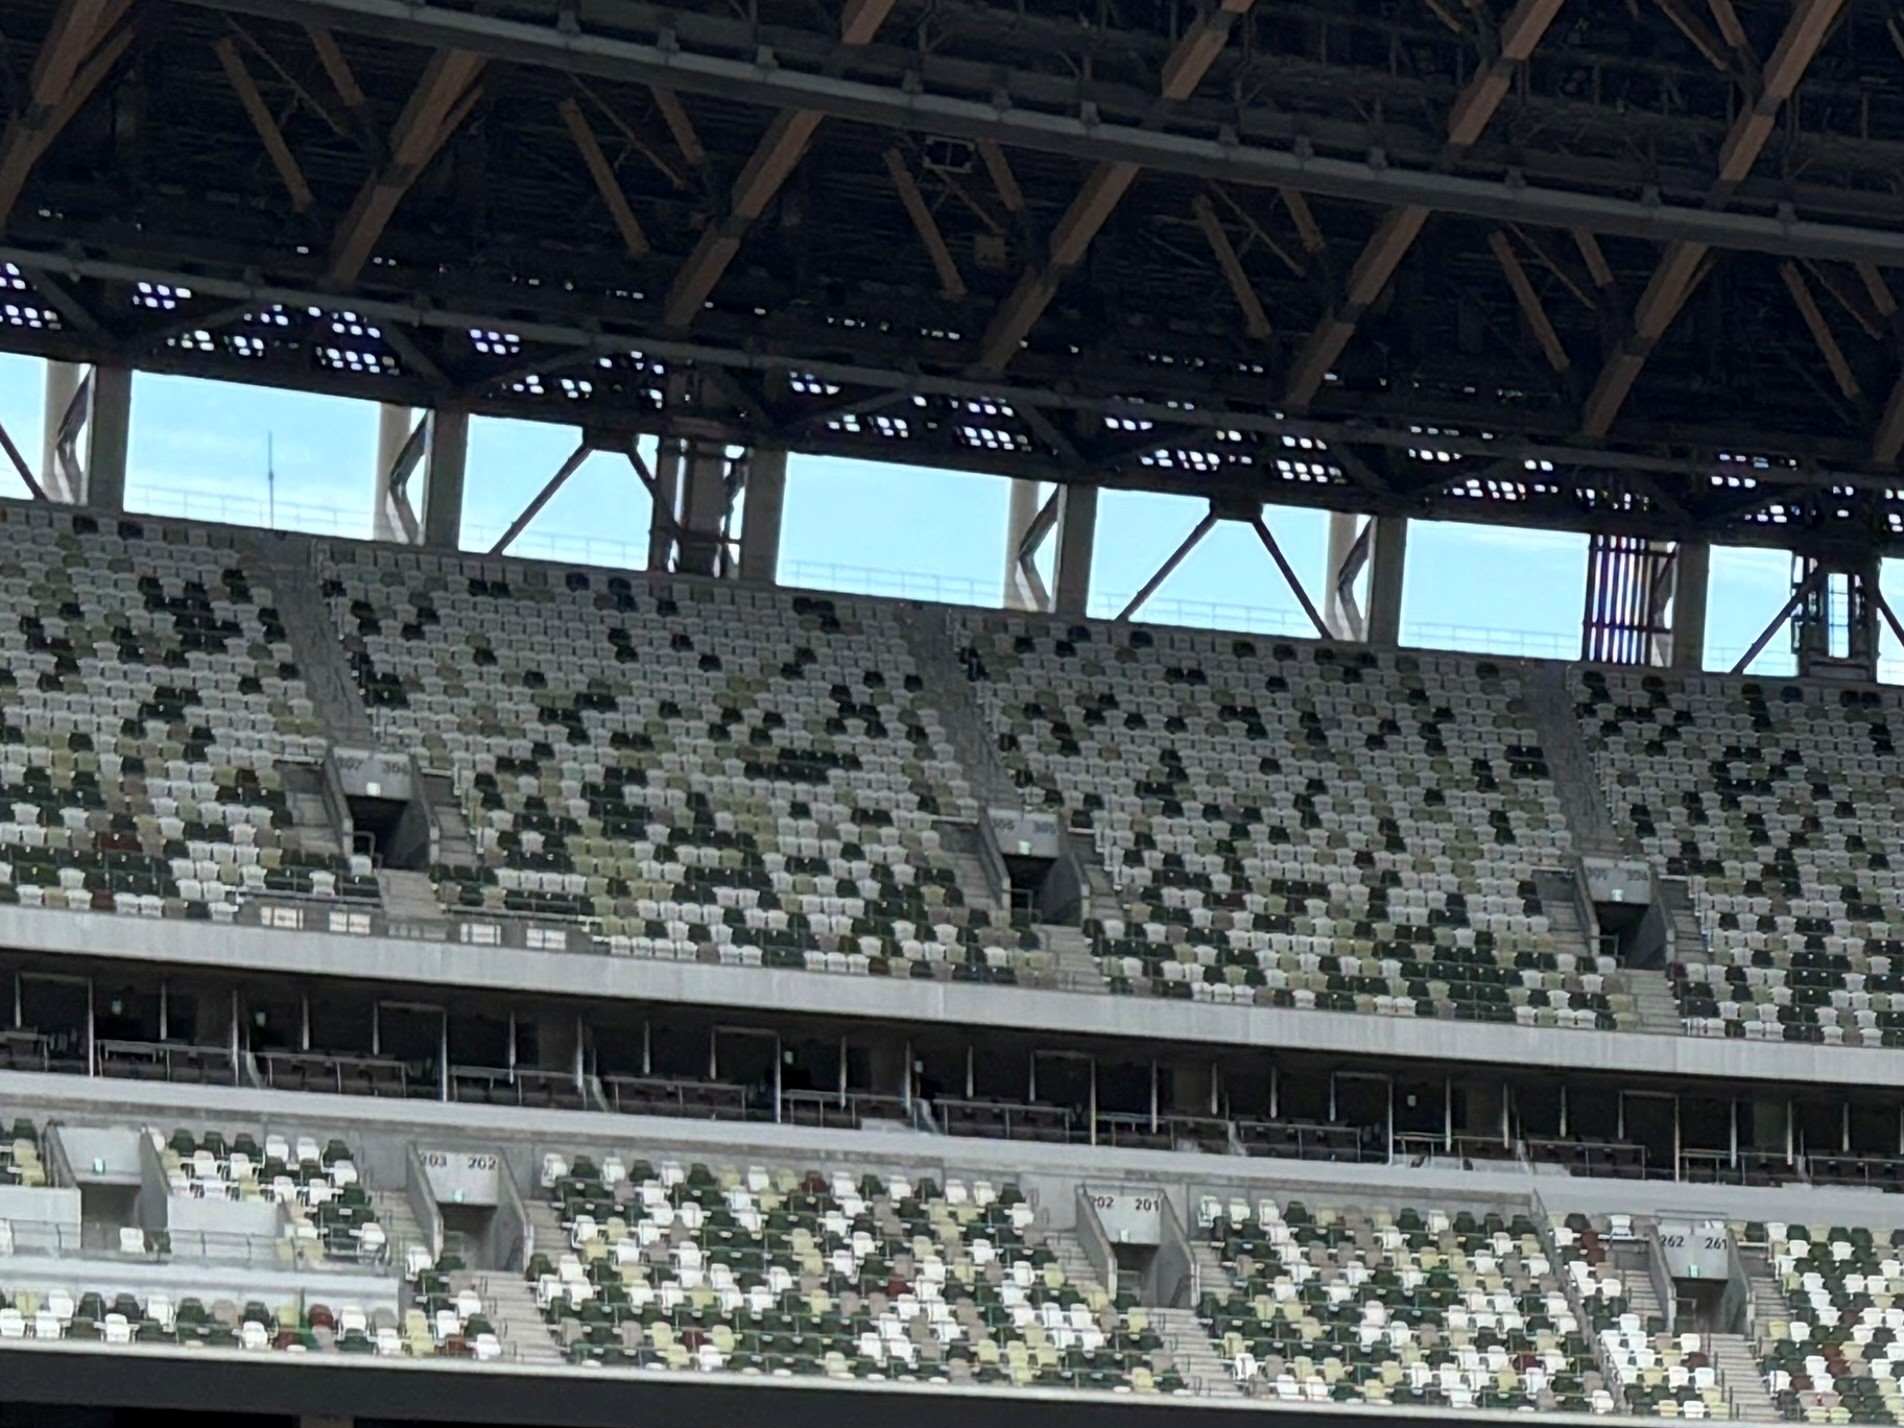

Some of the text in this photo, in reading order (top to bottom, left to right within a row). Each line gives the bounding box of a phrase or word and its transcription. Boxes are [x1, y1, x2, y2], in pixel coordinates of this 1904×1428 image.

[468, 1156, 497, 1170] 202
[1136, 1198, 1160, 1212] 201
[1660, 1235, 1728, 1250] 262 261
